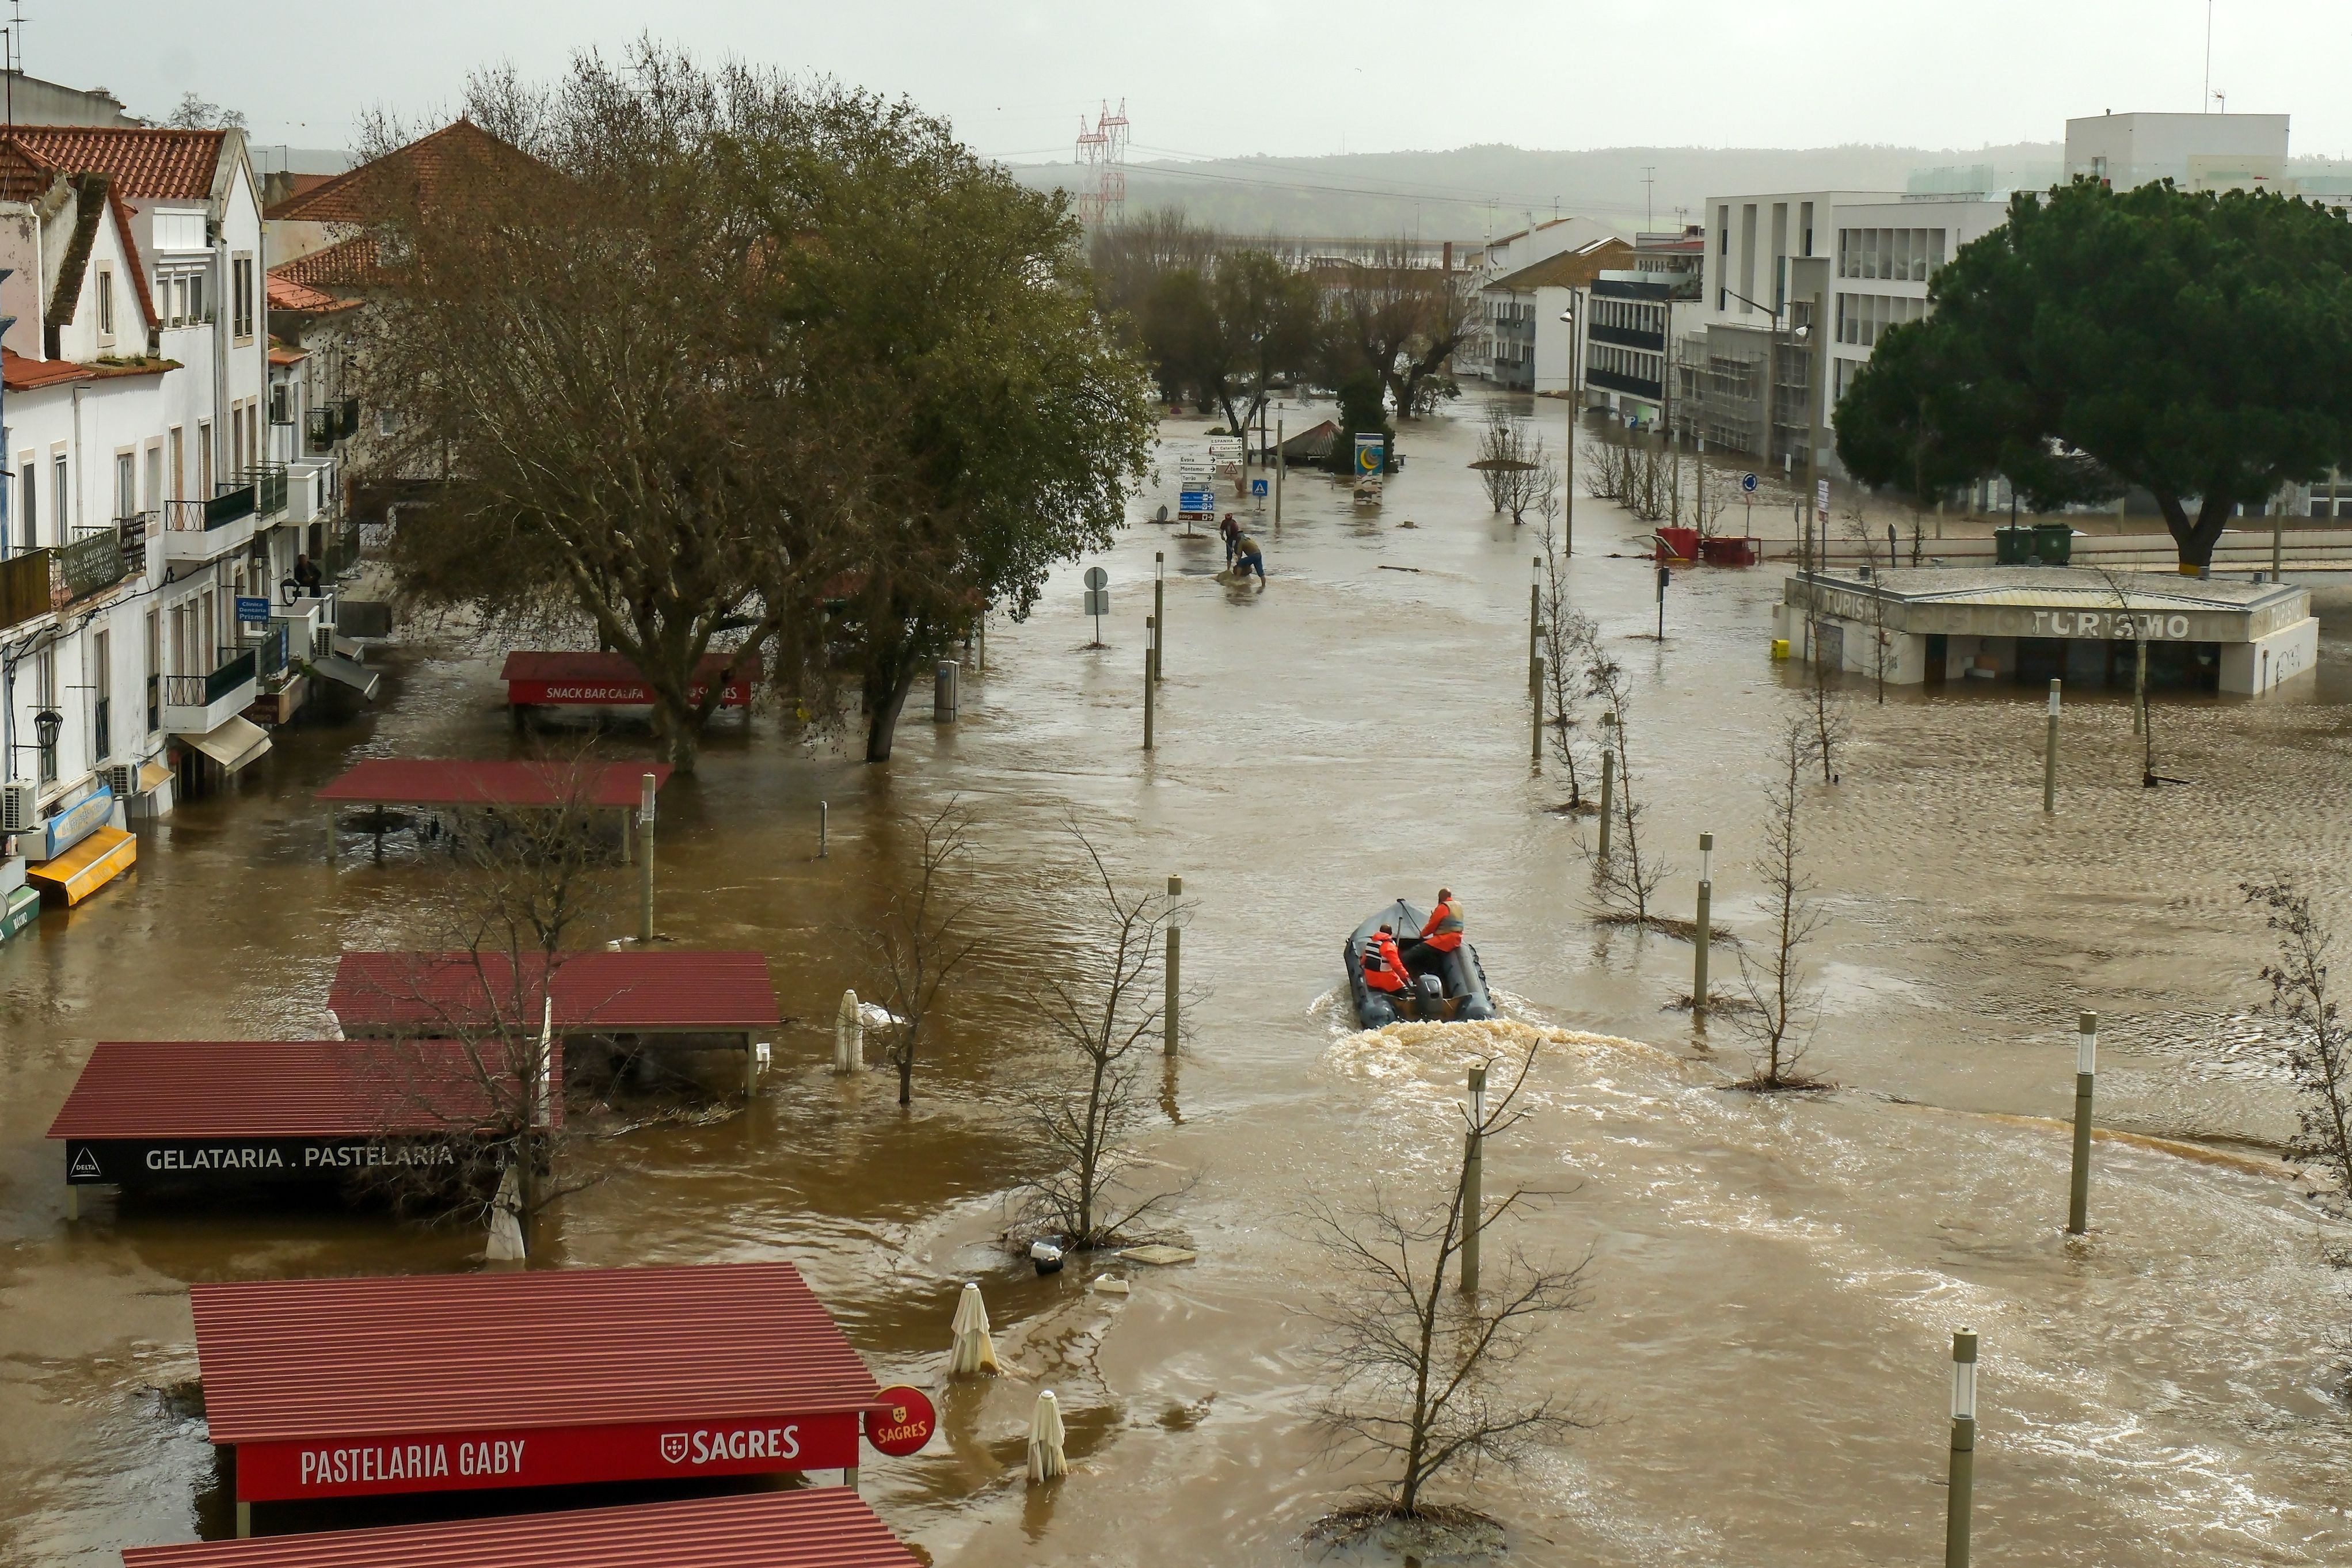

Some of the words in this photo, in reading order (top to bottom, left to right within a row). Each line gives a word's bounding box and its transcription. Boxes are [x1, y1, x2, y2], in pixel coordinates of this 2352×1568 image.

[546, 687, 583, 698] SNACK
[584, 688, 606, 699] BAR
[146, 1148, 283, 1170] GELATARIA
[305, 1145, 454, 1167] PASTELARIA
[692, 1425, 800, 1464] SAGRES
[878, 1421, 927, 1444] SAGRES
[301, 1444, 448, 1485] PASTELARIA
[459, 1440, 525, 1476] GABY
